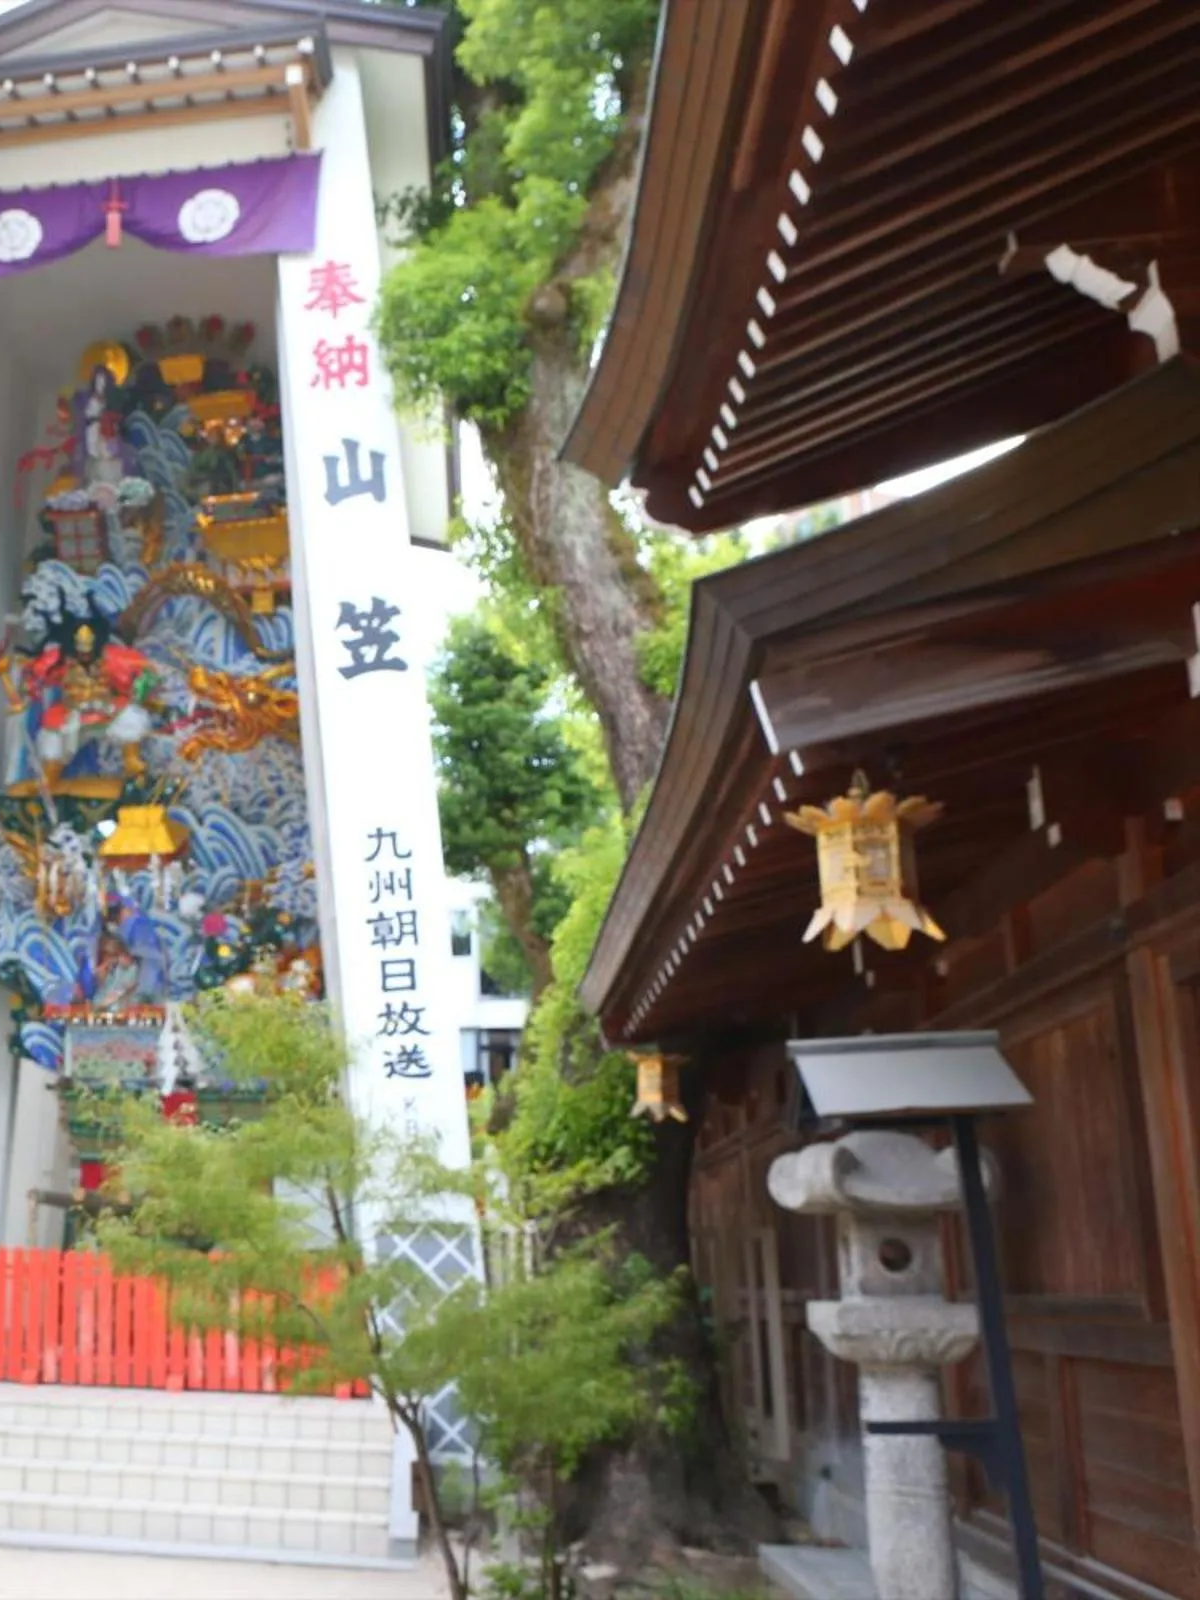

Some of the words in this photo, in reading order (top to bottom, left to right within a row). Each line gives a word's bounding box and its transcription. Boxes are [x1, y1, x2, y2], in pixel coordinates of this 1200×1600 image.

[305, 261, 371, 389] 奉納
[323, 438, 409, 681] 山笠
[364, 827, 433, 1080] 九州朝日放送
